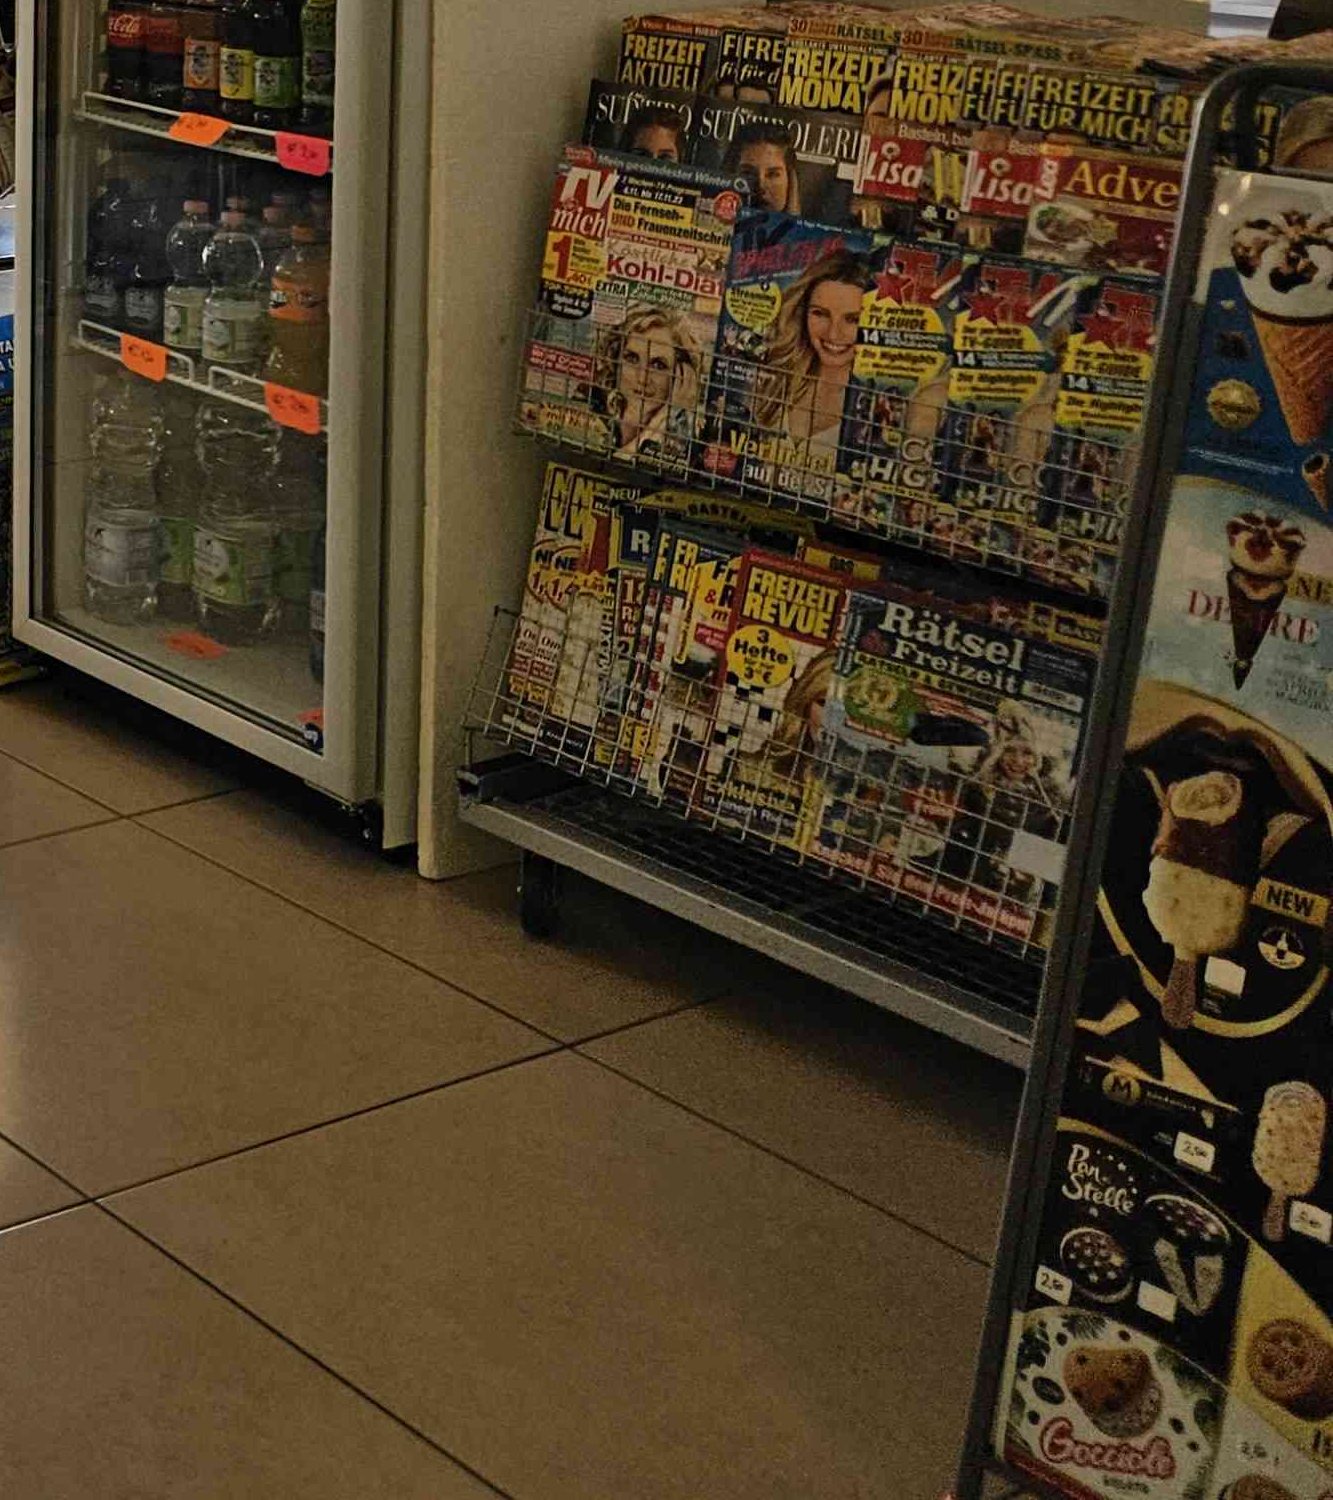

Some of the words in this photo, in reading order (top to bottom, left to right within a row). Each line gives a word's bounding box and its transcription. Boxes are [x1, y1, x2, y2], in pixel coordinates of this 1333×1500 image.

[623, 33, 707, 65] FREIZEIT
[783, 48, 886, 86] FREIZEIT
[1030, 71, 1155, 114] FREIZEIT
[1079, 107, 1154, 146] MICH
[864, 144, 924, 187] Lisa
[971, 160, 1033, 206] Lisa
[560, 166, 621, 210] TV
[551, 205, 607, 239] mich
[613, 198, 631, 212] Die
[633, 201, 685, 221] Fernseh-
[867, 315, 928, 332] TV-GUIDE
[748, 564, 841, 612] FREIZEIT
[742, 590, 833, 638] REVUE
[734, 639, 788, 663] Hefte
[757, 629, 769, 643] 3
[877, 600, 1027, 671] Rätsel
[891, 637, 1018, 696] Freizeit
[1264, 884, 1316, 918] NEW
[1067, 1142, 1102, 1184] Pan
[1061, 1171, 1135, 1217] Stelle
